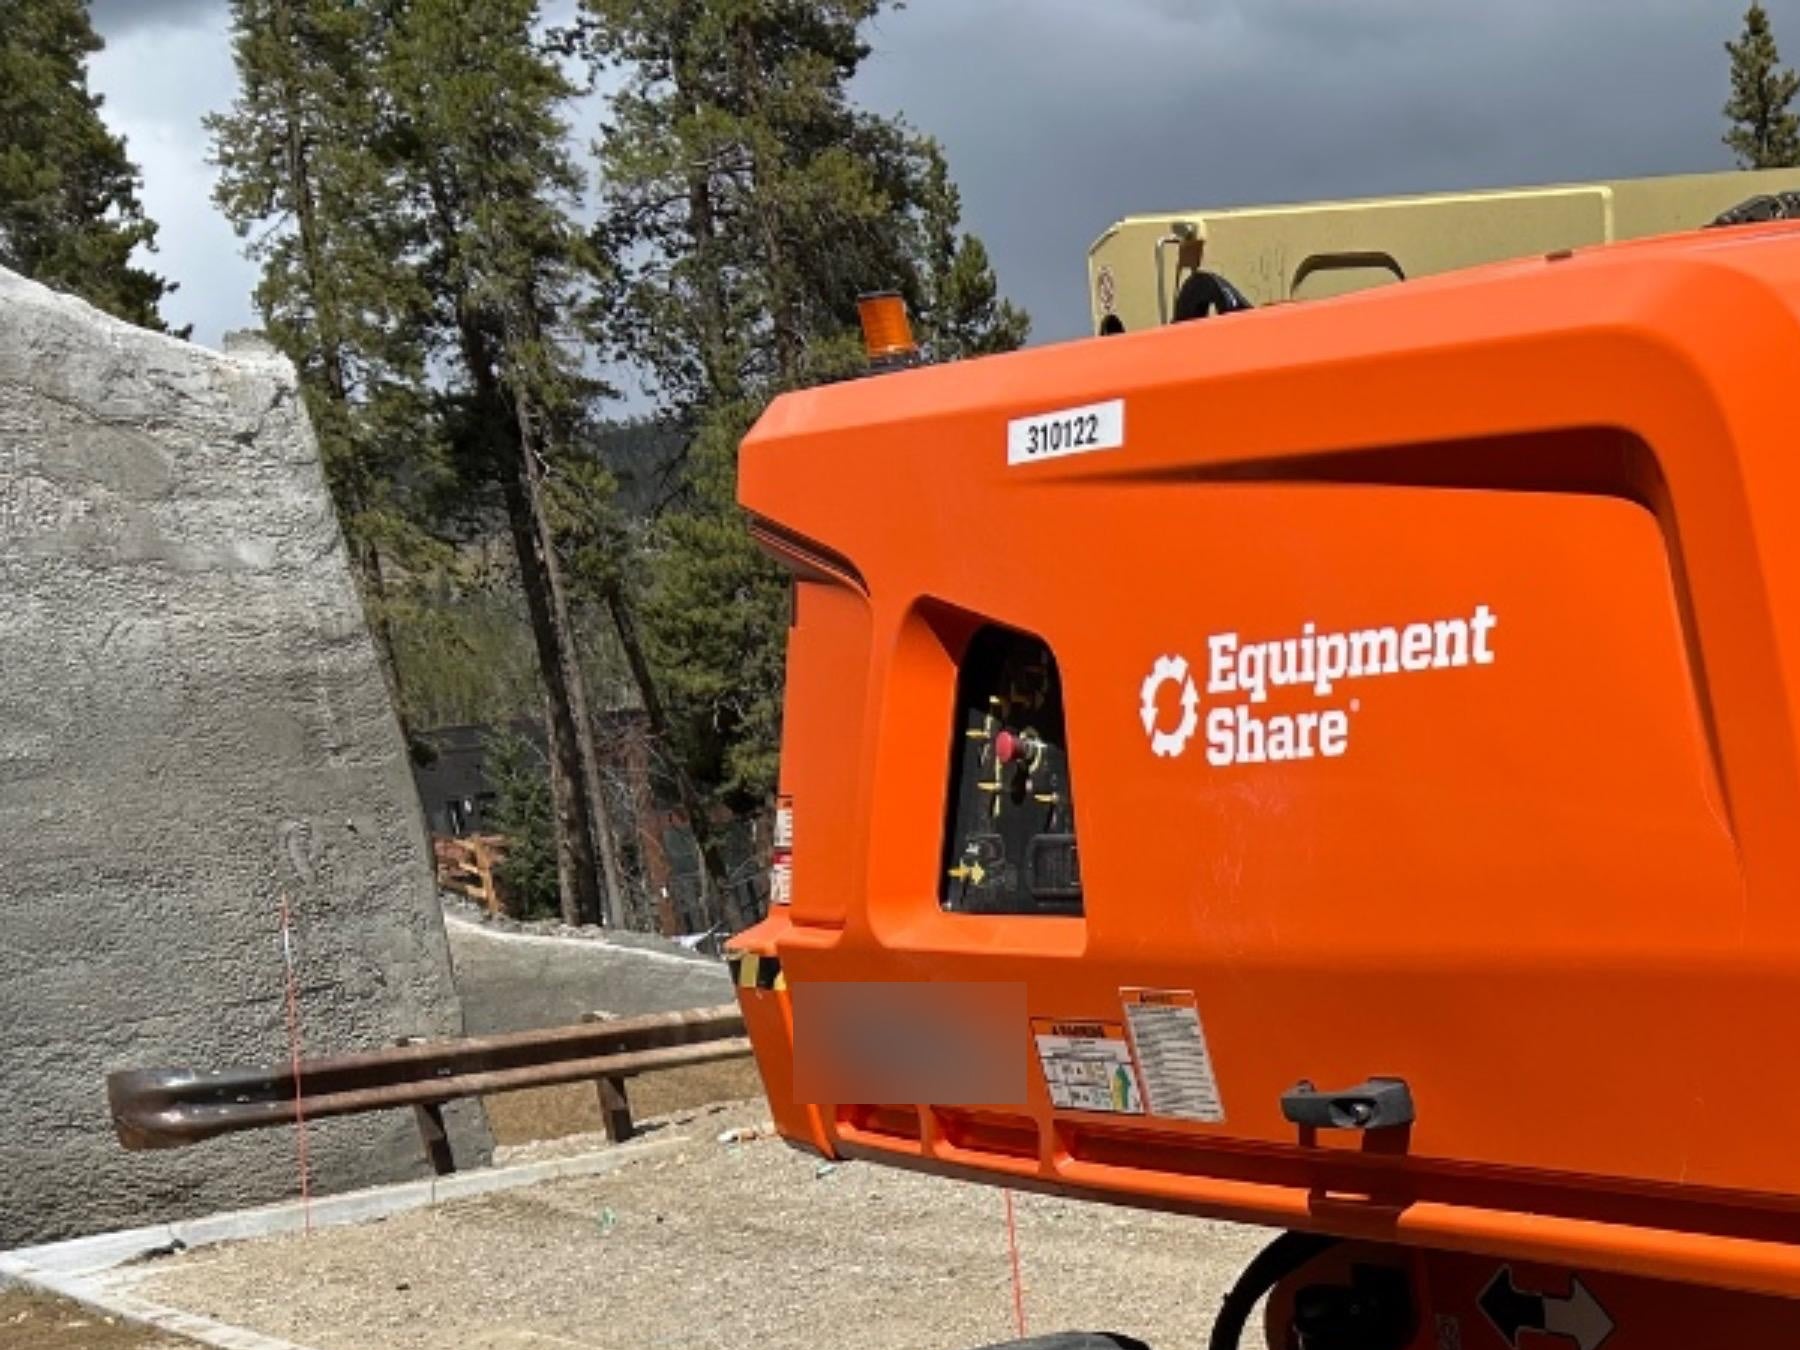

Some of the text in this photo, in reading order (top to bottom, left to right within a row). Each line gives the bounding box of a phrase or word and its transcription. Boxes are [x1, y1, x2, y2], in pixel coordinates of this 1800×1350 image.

[1026, 413, 1099, 454] 310122
[1206, 604, 1497, 703] Equipment
[1205, 704, 1349, 767] Share
